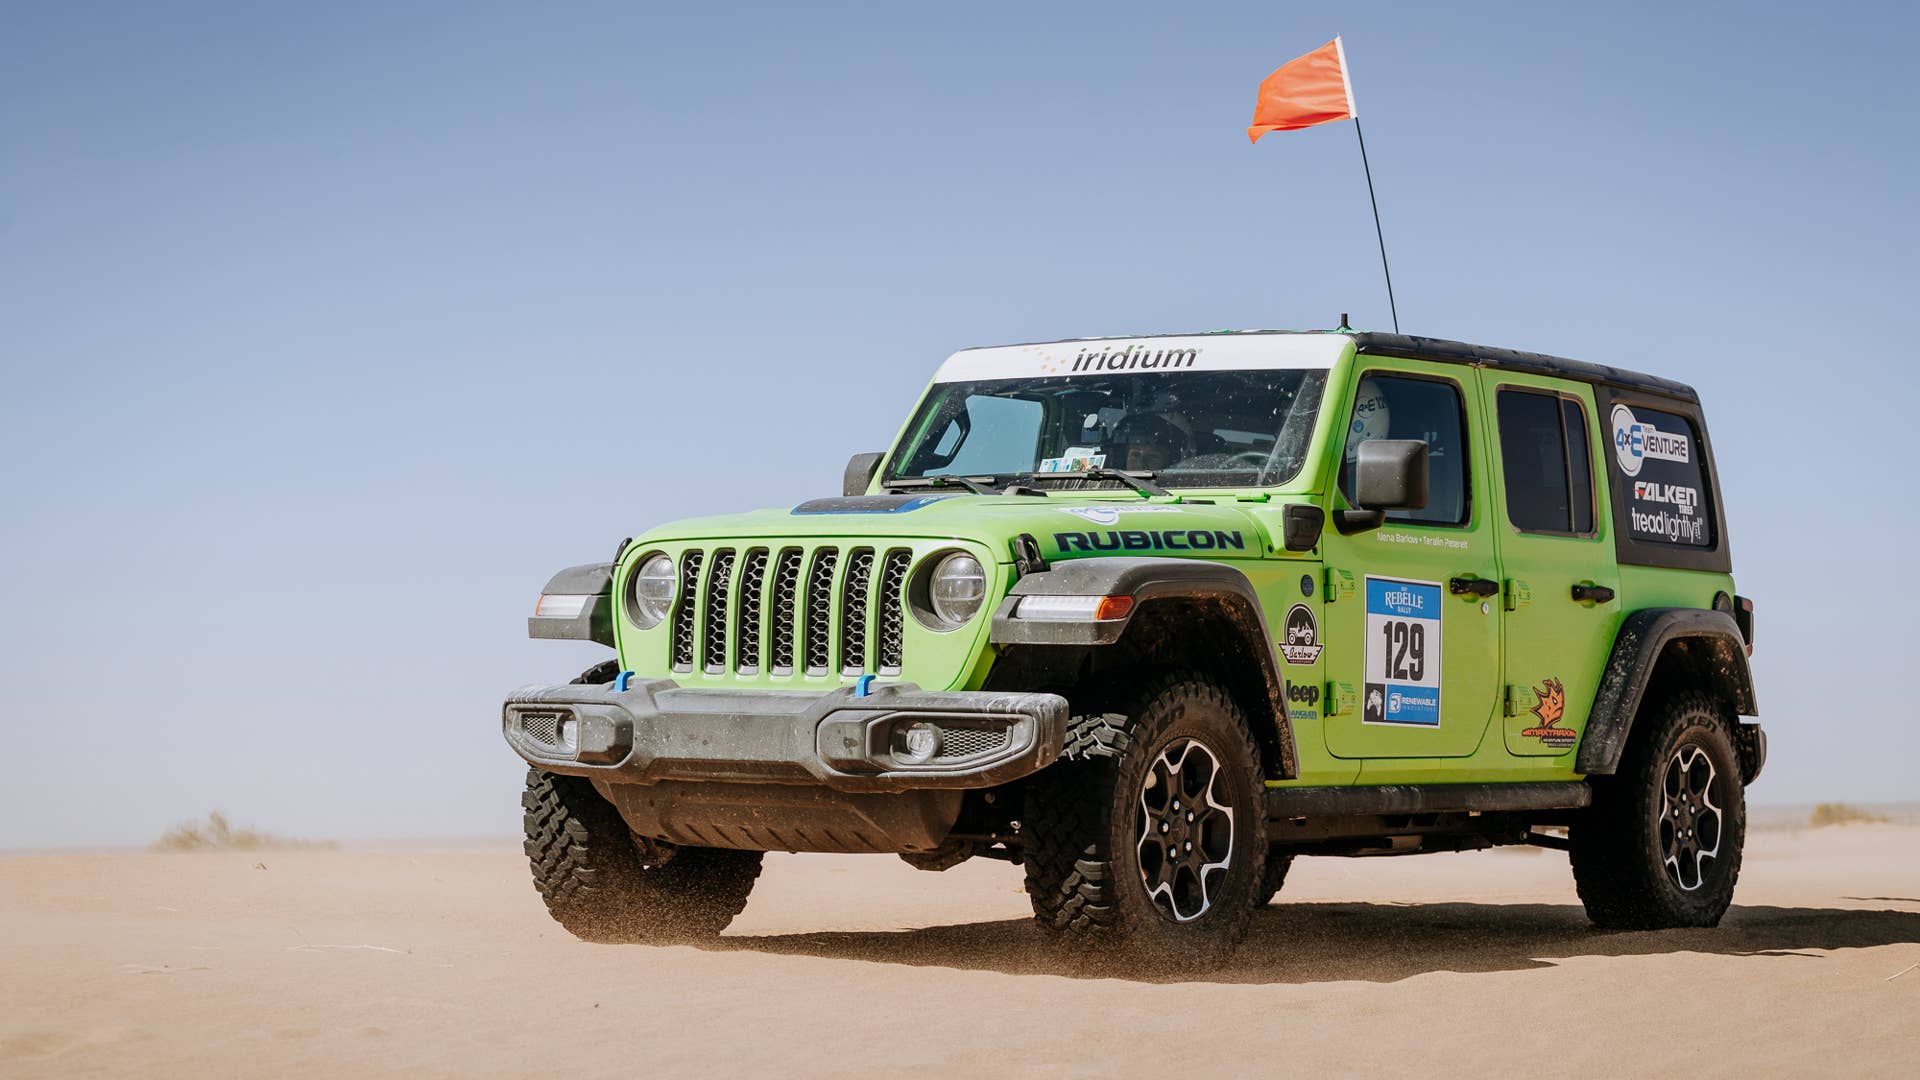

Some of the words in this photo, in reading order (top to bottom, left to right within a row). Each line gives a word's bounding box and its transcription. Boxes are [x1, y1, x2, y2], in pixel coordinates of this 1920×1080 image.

[1072, 344, 1198, 372] iridium
[1633, 481, 1697, 507] FALKEN
[1053, 530, 1245, 553] RUBICON
[1385, 591, 1424, 610] REBELLE
[1383, 620, 1424, 682] 129
[1401, 696, 1437, 707] RENEWABLE
